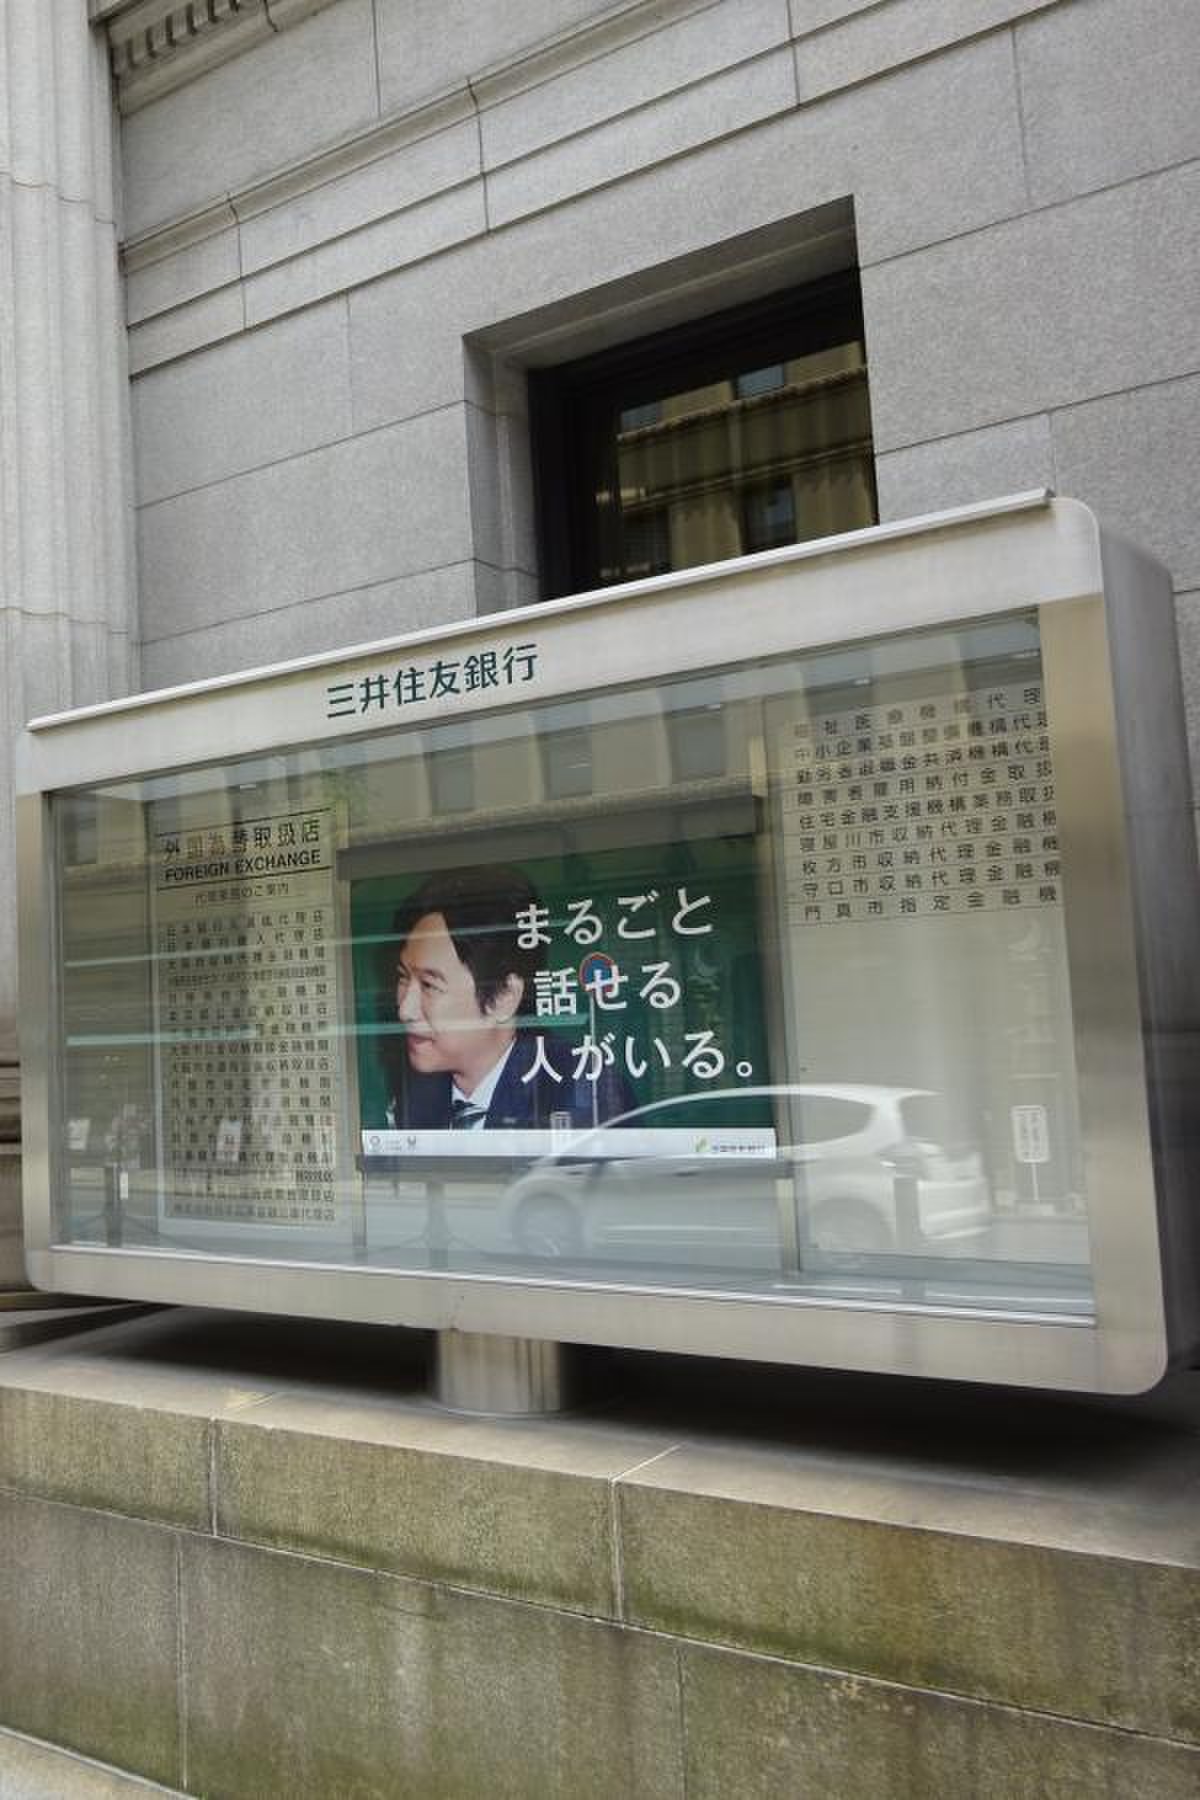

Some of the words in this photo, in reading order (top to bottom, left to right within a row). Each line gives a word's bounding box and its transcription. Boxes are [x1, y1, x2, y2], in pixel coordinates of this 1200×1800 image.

[326, 643, 538, 719] 三井住友銀行
[165, 861, 230, 882] FOREIGN
[234, 848, 321, 873] EXCHANGE
[515, 887, 713, 950] まるごと
[533, 961, 681, 1016] 話せる
[521, 1028, 753, 1084] 人がいる。
